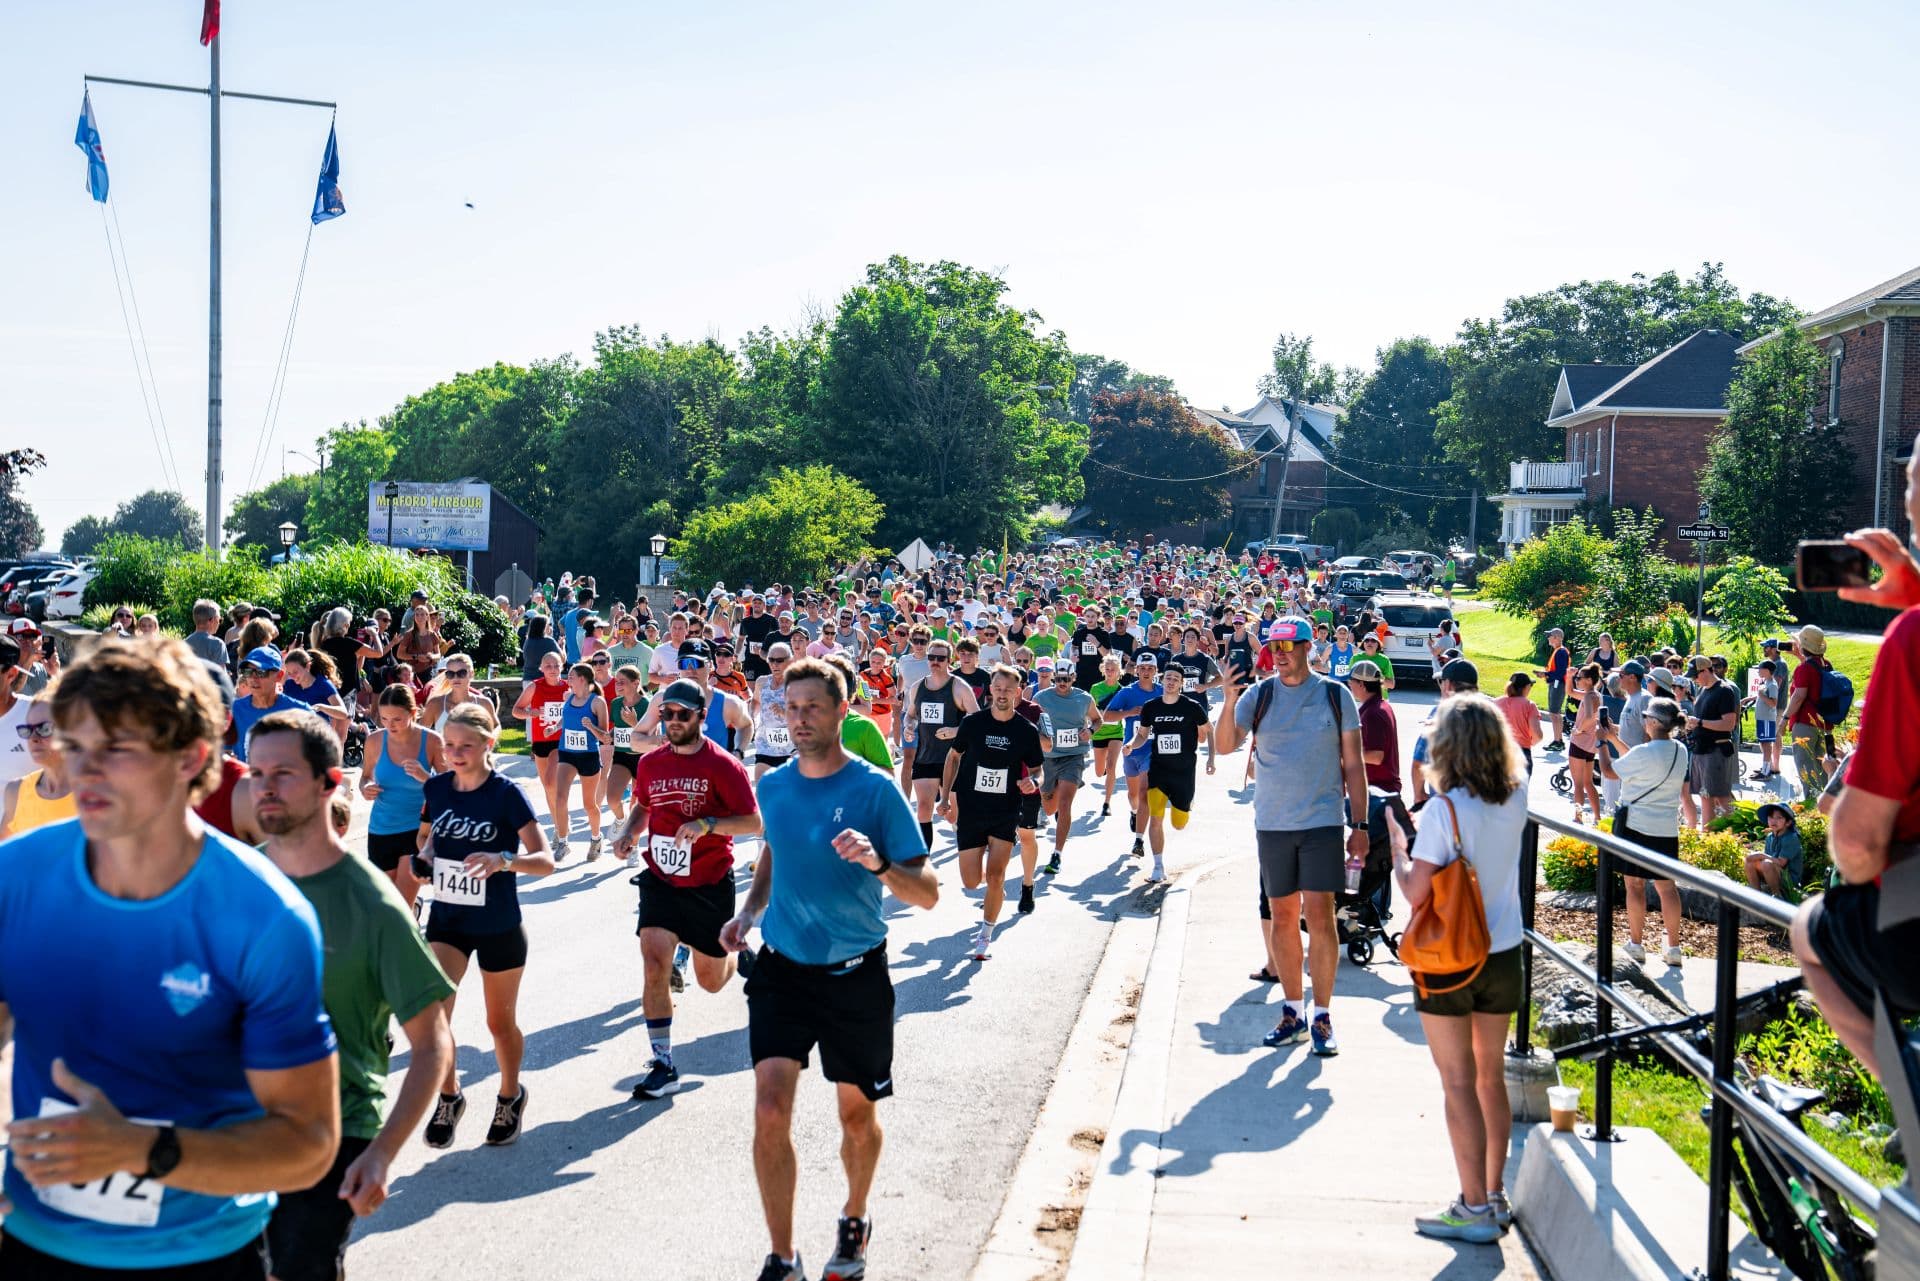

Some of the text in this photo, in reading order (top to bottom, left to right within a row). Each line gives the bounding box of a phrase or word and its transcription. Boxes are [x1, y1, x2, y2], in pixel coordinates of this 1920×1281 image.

[431, 496, 483, 508] HARBOUR
[1680, 528, 1727, 538] Denmark St
[924, 708, 939, 719] 525
[1155, 715, 1185, 723] CCM
[566, 735, 586, 746] 1916
[615, 733, 631, 743] 560
[768, 734, 788, 743] 1464
[1058, 733, 1078, 744] 1445
[1159, 740, 1179, 750] 1580
[981, 776, 1002, 788] 557
[654, 847, 687, 866] 1502
[438, 872, 480, 896] 1440
